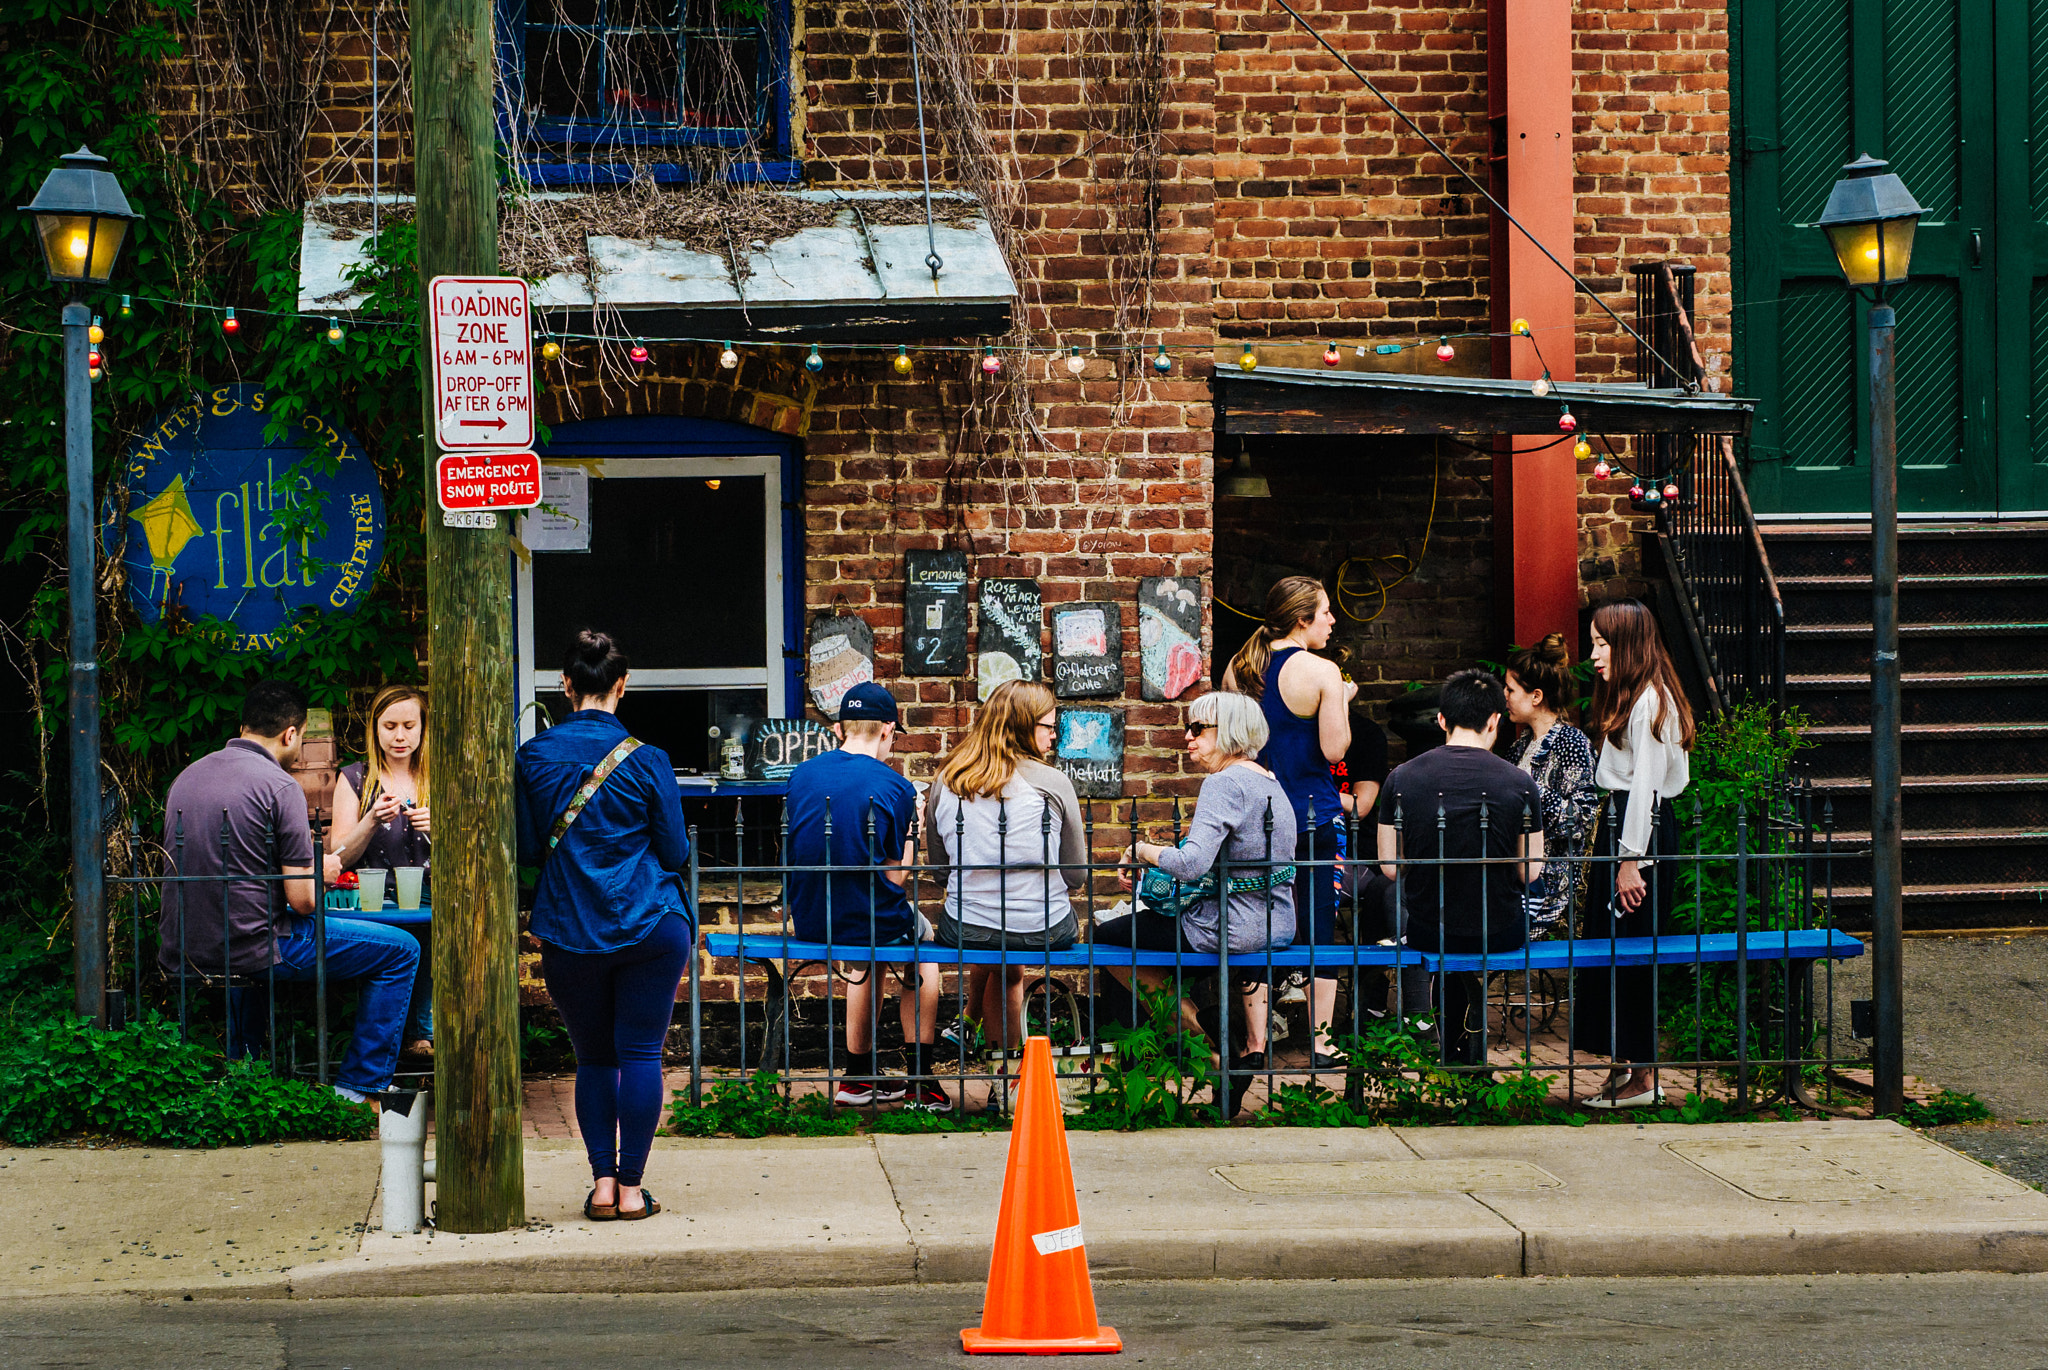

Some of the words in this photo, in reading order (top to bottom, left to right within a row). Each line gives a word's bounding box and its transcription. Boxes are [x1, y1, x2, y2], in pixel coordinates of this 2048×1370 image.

[440, 296, 522, 317] LOADING
[457, 323, 509, 343] ZONE
[447, 376, 522, 392] DROP-OFF
[444, 396, 490, 411] AFTER
[447, 464, 531, 480] EMERGENCY
[446, 484, 485, 498] SNOW
[490, 481, 535, 496] ROUTE
[908, 562, 968, 585] Lemonade
[984, 580, 1018, 594] ROSE
[1004, 592, 1040, 603] MARY
[1019, 613, 1041, 623] ADE
[848, 700, 862, 708] DG
[762, 730, 838, 766] OPEN
